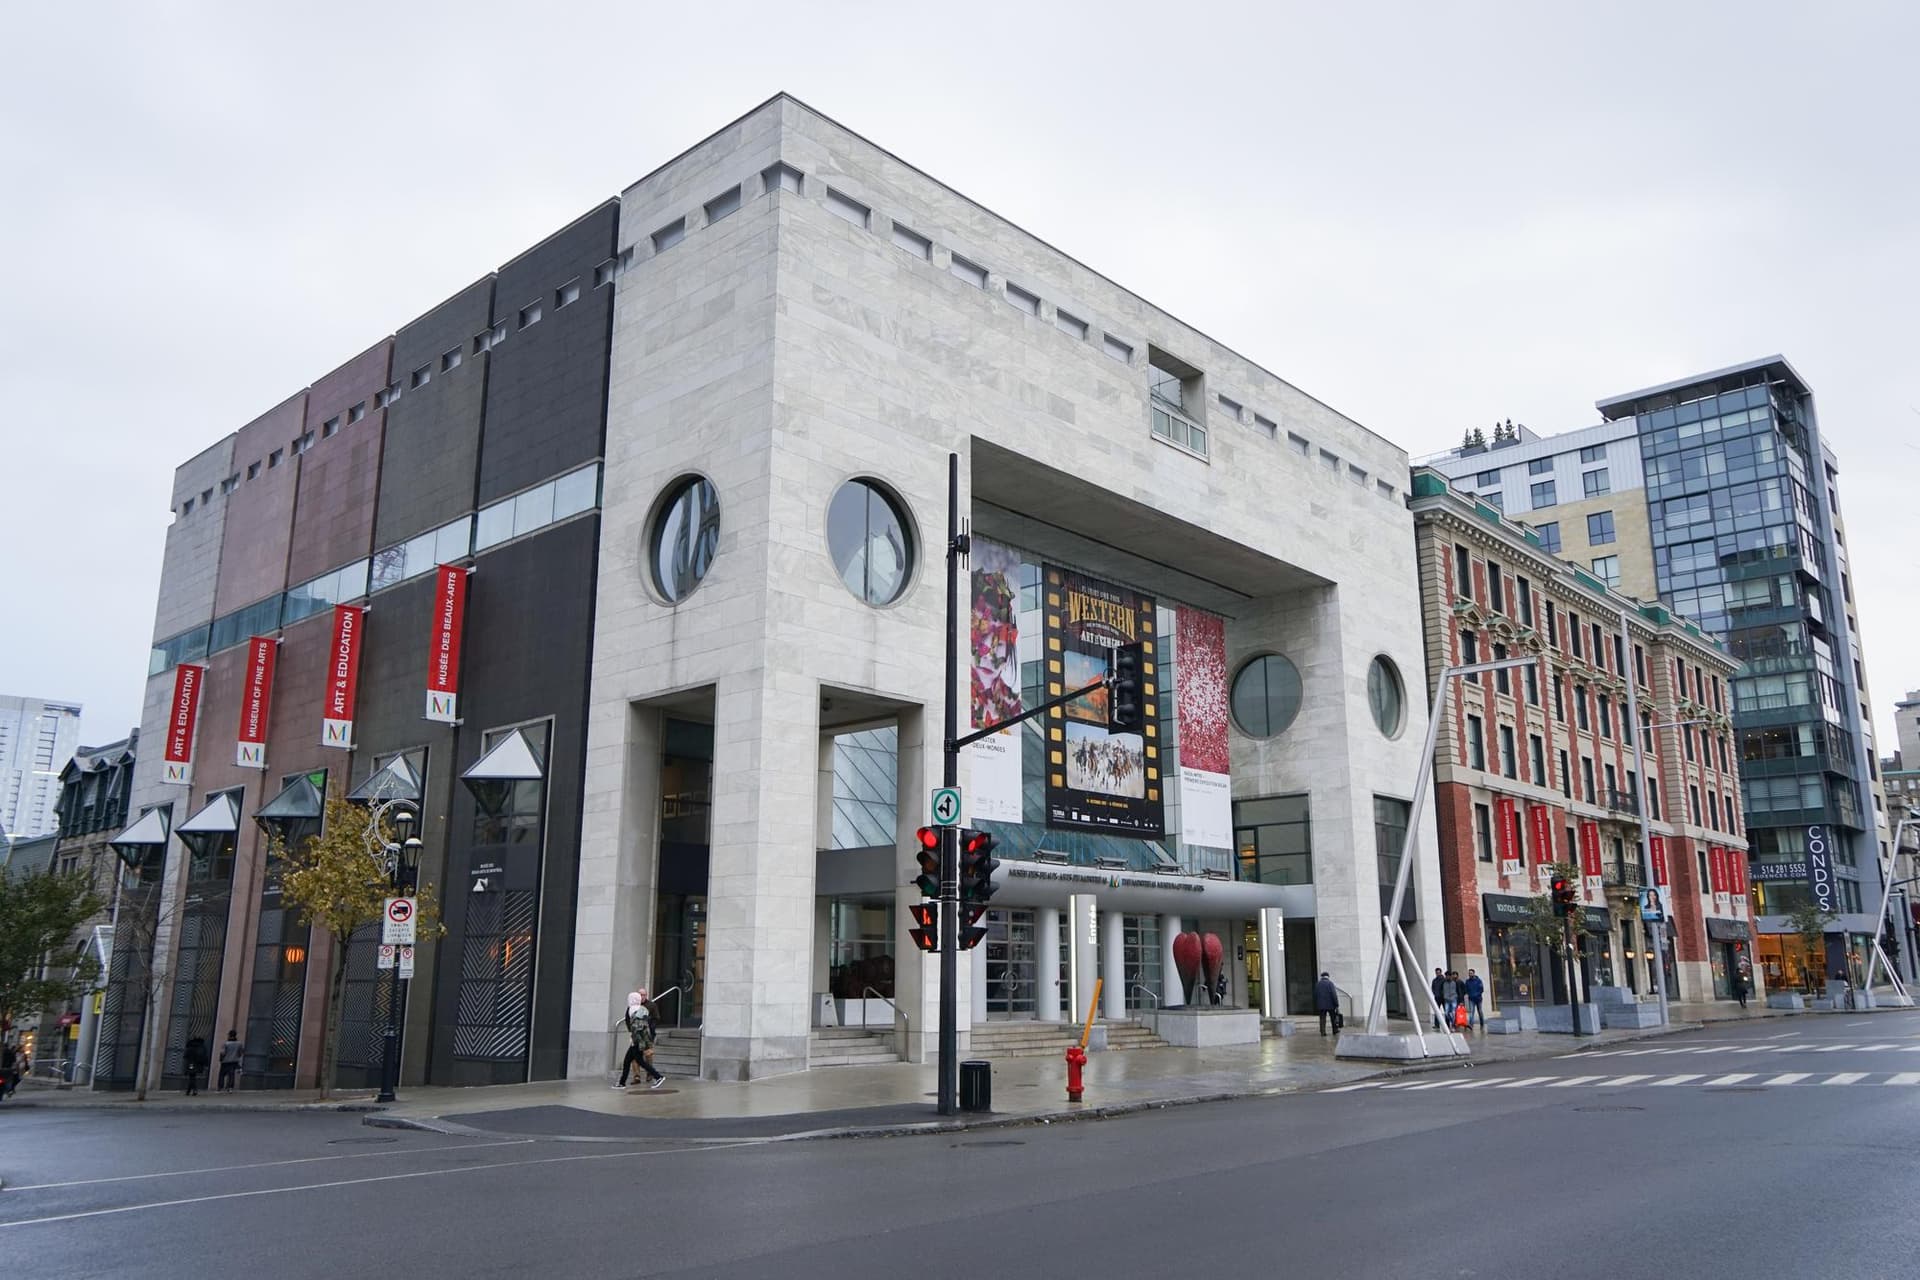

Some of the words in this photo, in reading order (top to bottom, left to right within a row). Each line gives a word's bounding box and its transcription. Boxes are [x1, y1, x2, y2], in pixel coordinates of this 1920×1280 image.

[444, 572, 457, 630] BEAUX-ARTS
[1068, 590, 1135, 642] WESTERN
[258, 642, 267, 665] ARTS
[337, 612, 354, 677] EDUCATION
[442, 632, 451, 651] DES
[255, 666, 265, 685] FINE
[439, 654, 449, 686] MUSÉE
[178, 670, 195, 725] EDUCATION
[253, 686, 262, 698] OF
[337, 680, 347, 688] &
[334, 691, 346, 714] ART
[248, 700, 260, 738] MUSEUM
[174, 738, 184, 756] ART
[1761, 865, 1774, 875] 514
[1775, 864, 1788, 874] 281
[1789, 863, 1806, 873] 5552
[1808, 825, 1830, 911] CONDOS
[1088, 904, 1097, 944] Entrée
